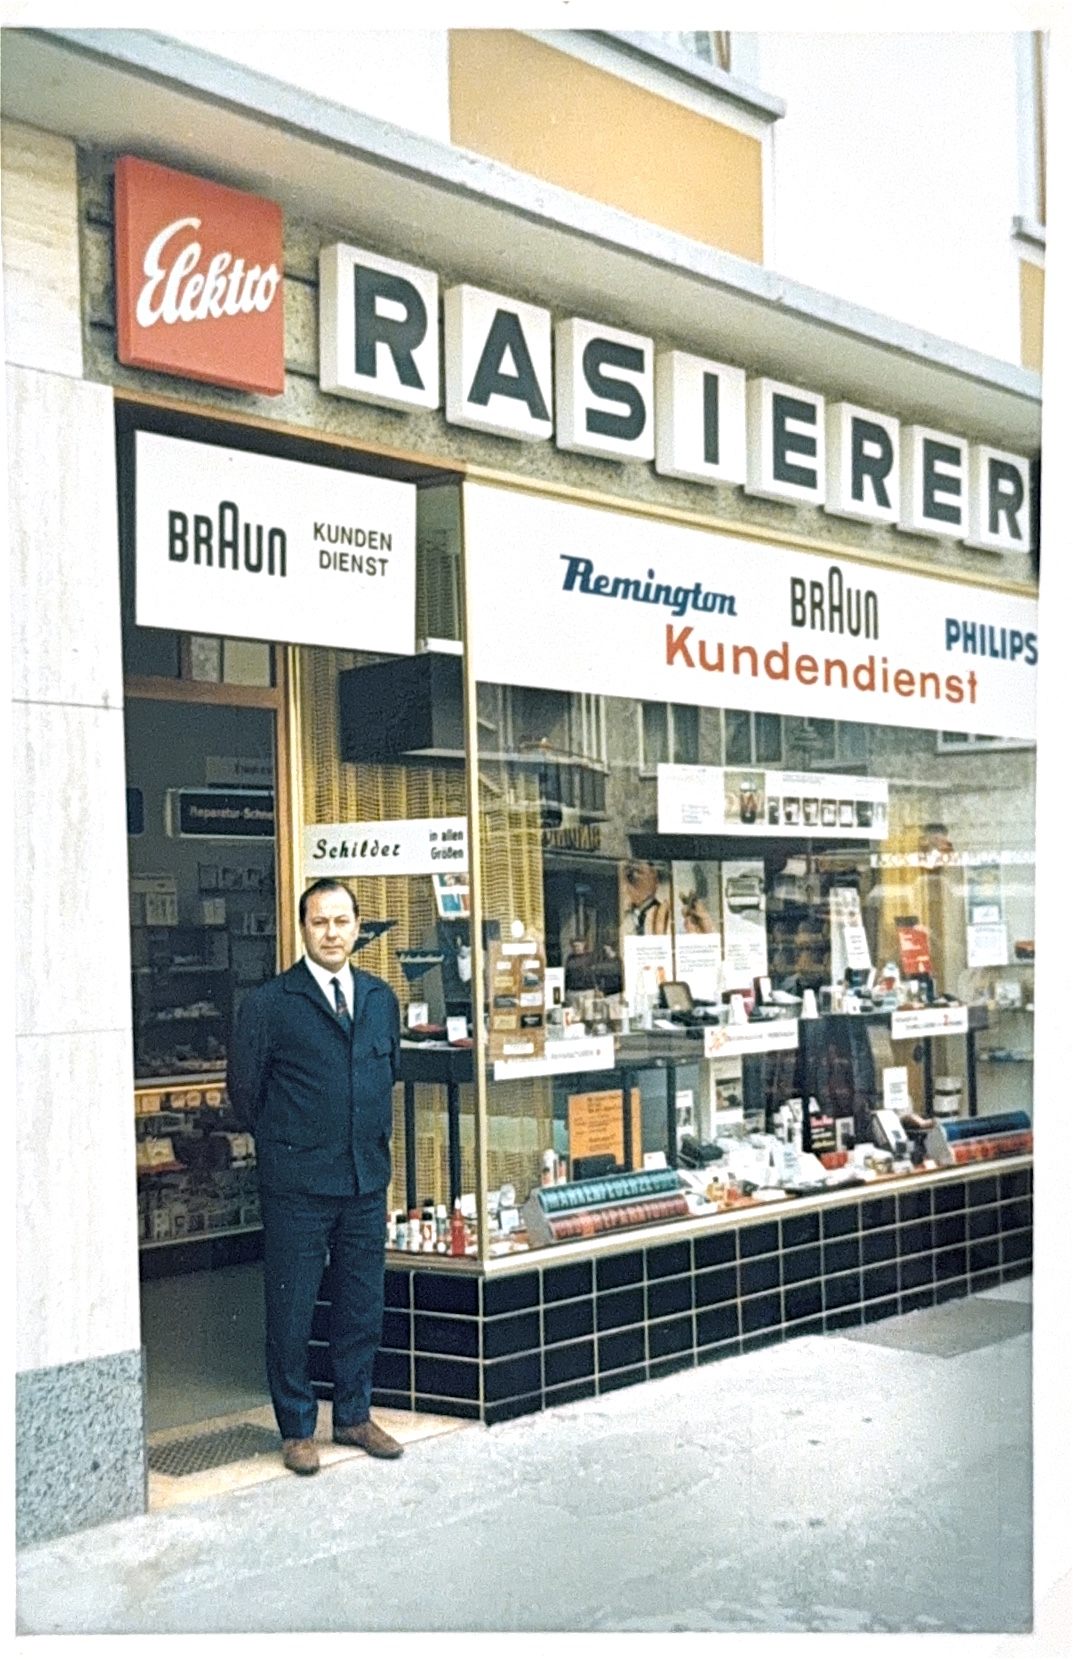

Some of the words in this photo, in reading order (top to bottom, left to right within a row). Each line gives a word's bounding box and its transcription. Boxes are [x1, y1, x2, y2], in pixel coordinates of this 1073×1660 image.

[135, 216, 281, 328] Elektro
[353, 263, 1025, 541] RASIERER
[168, 500, 287, 577] BRAUN
[313, 521, 392, 551] KUNDEN
[318, 550, 389, 577] DIENST
[560, 554, 737, 617] Remington
[790, 566, 879, 640] BRAUN
[666, 624, 978, 704] Kundendienst
[945, 617, 1038, 666] PHILIPS
[312, 838, 401, 860] Schilder
[429, 830, 438, 842] in
[441, 828, 464, 842] allen
